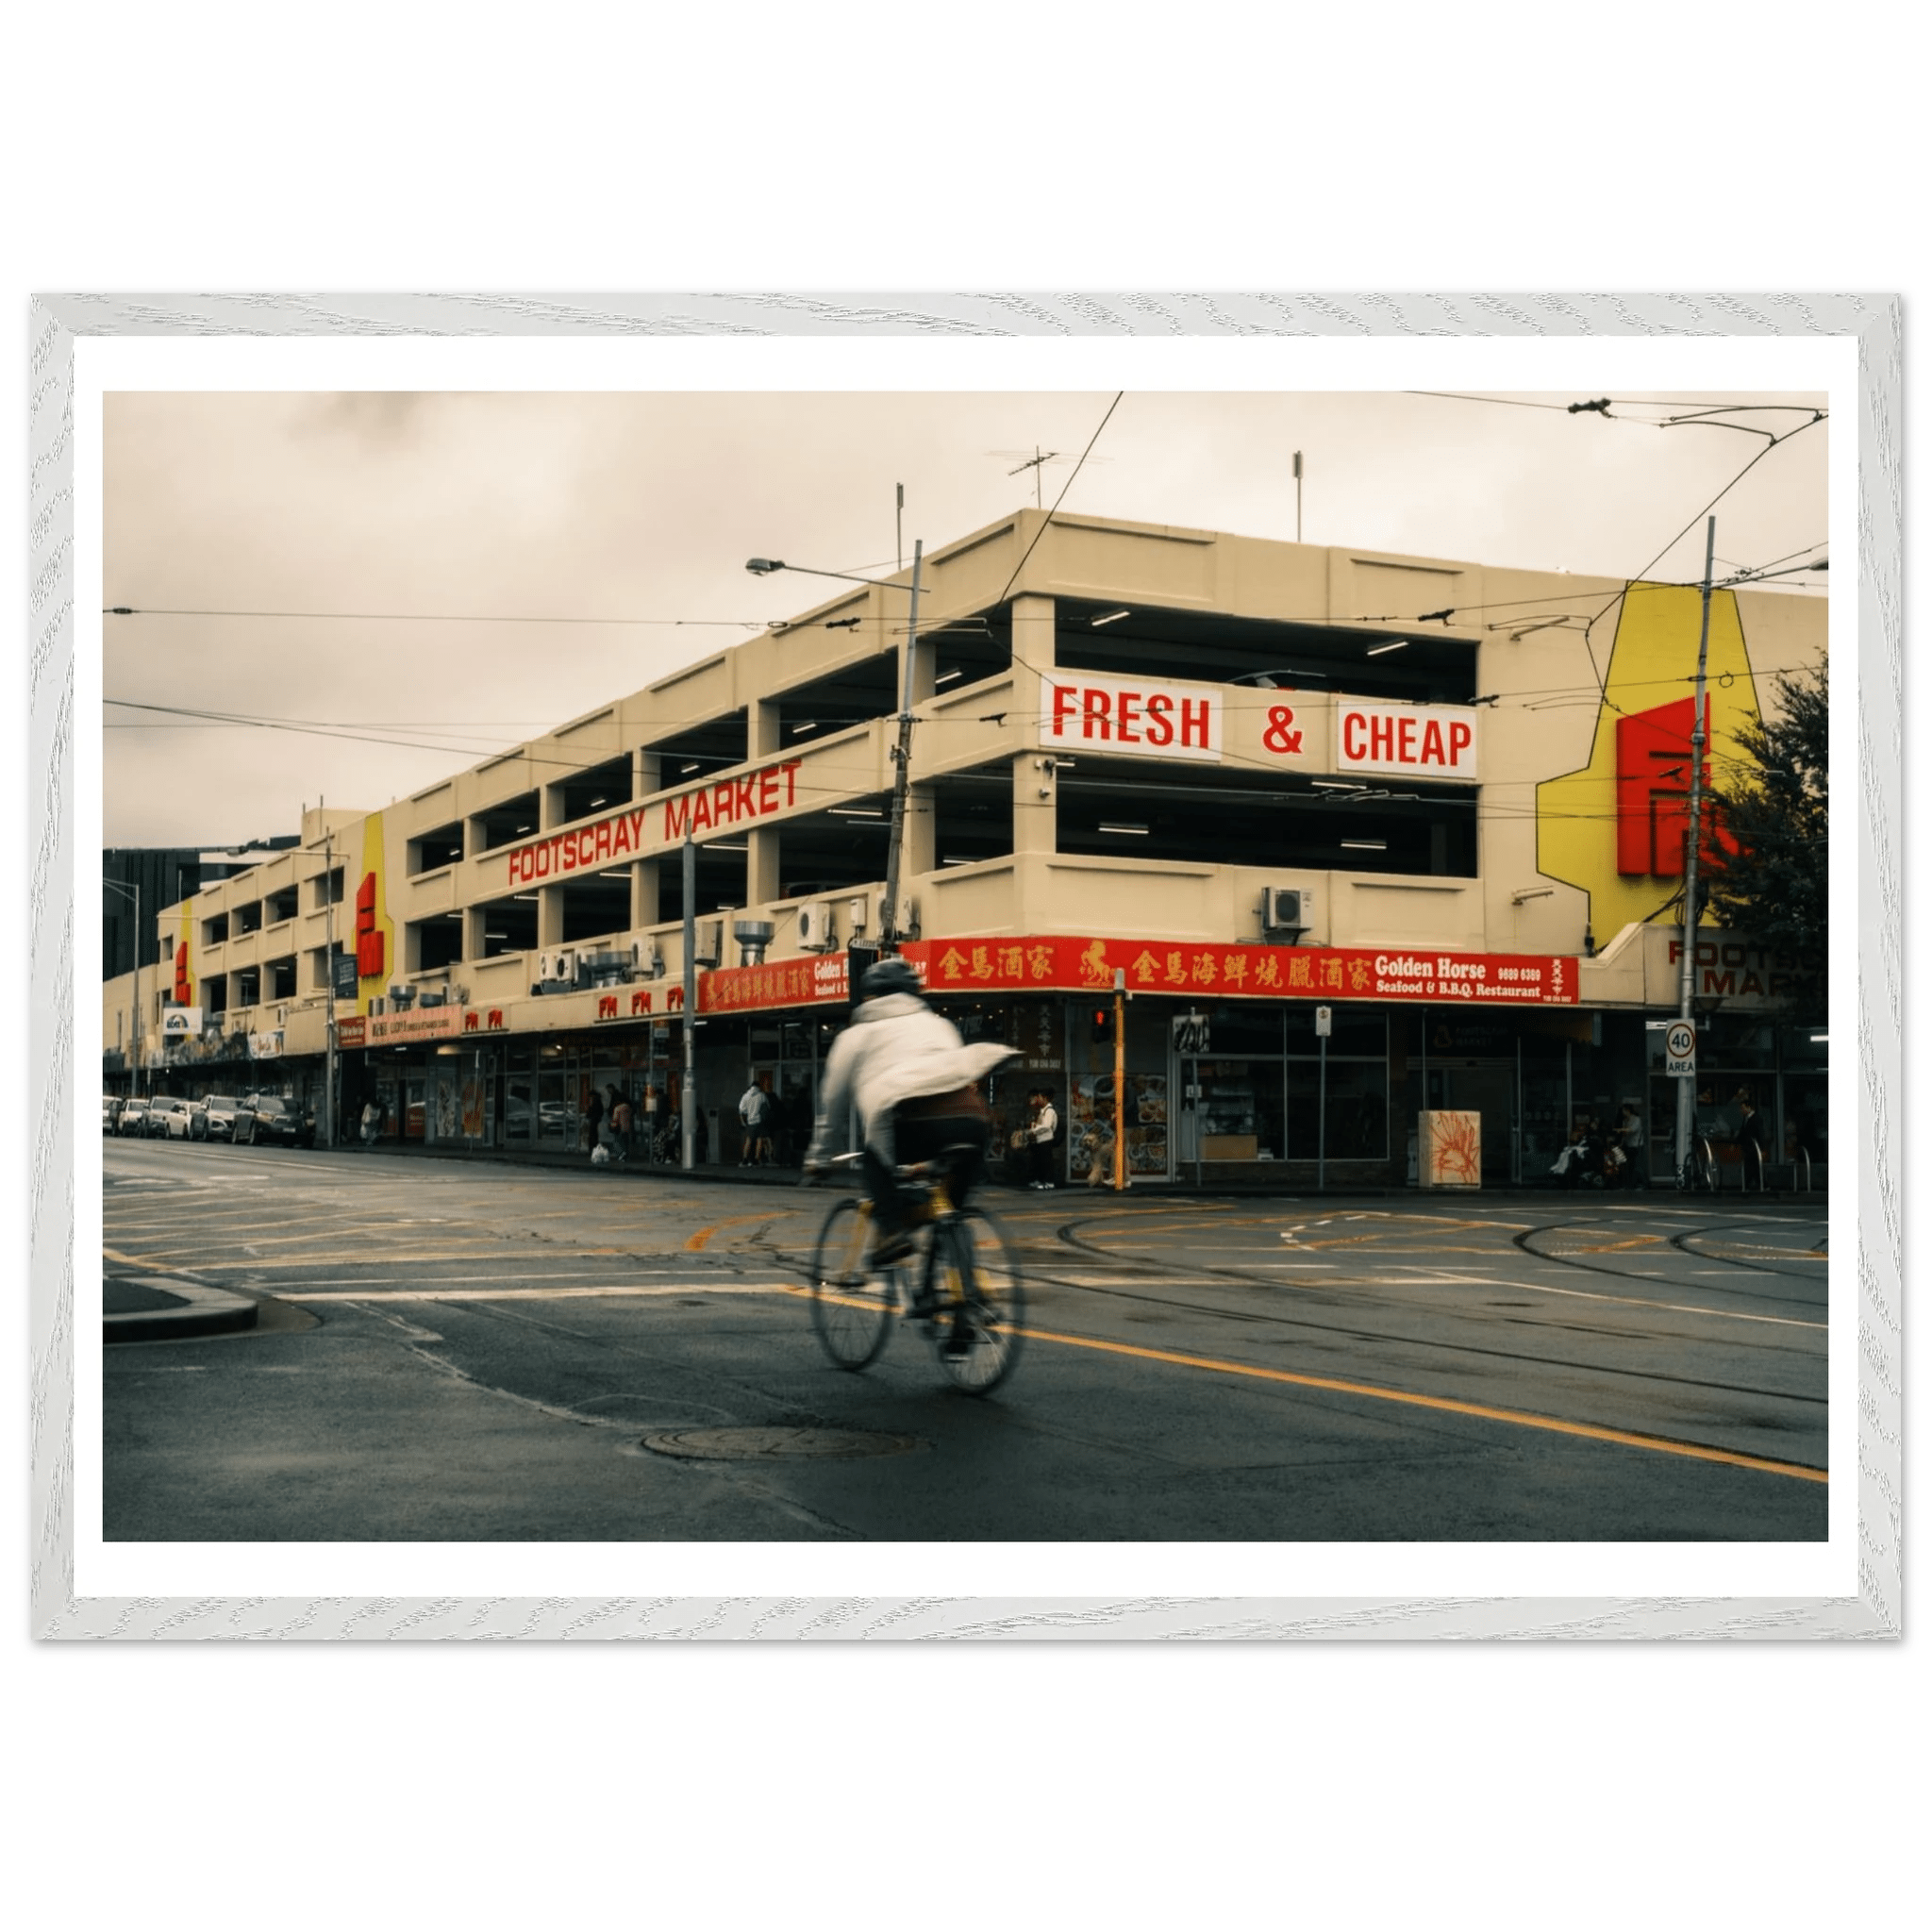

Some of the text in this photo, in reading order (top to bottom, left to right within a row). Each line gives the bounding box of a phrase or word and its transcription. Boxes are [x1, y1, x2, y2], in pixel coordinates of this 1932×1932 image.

[1052, 685, 1473, 766] FRESH & CHEAP
[508, 759, 802, 886] FOOTSCRAY MARKET
[814, 960, 841, 980] Golden
[1375, 956, 1486, 979] Golden Horse
[1376, 979, 1423, 993] Seafood
[1476, 983, 1541, 997] Restaurant
[1672, 1033, 1690, 1048] 40
[1668, 1061, 1694, 1072] AREA
